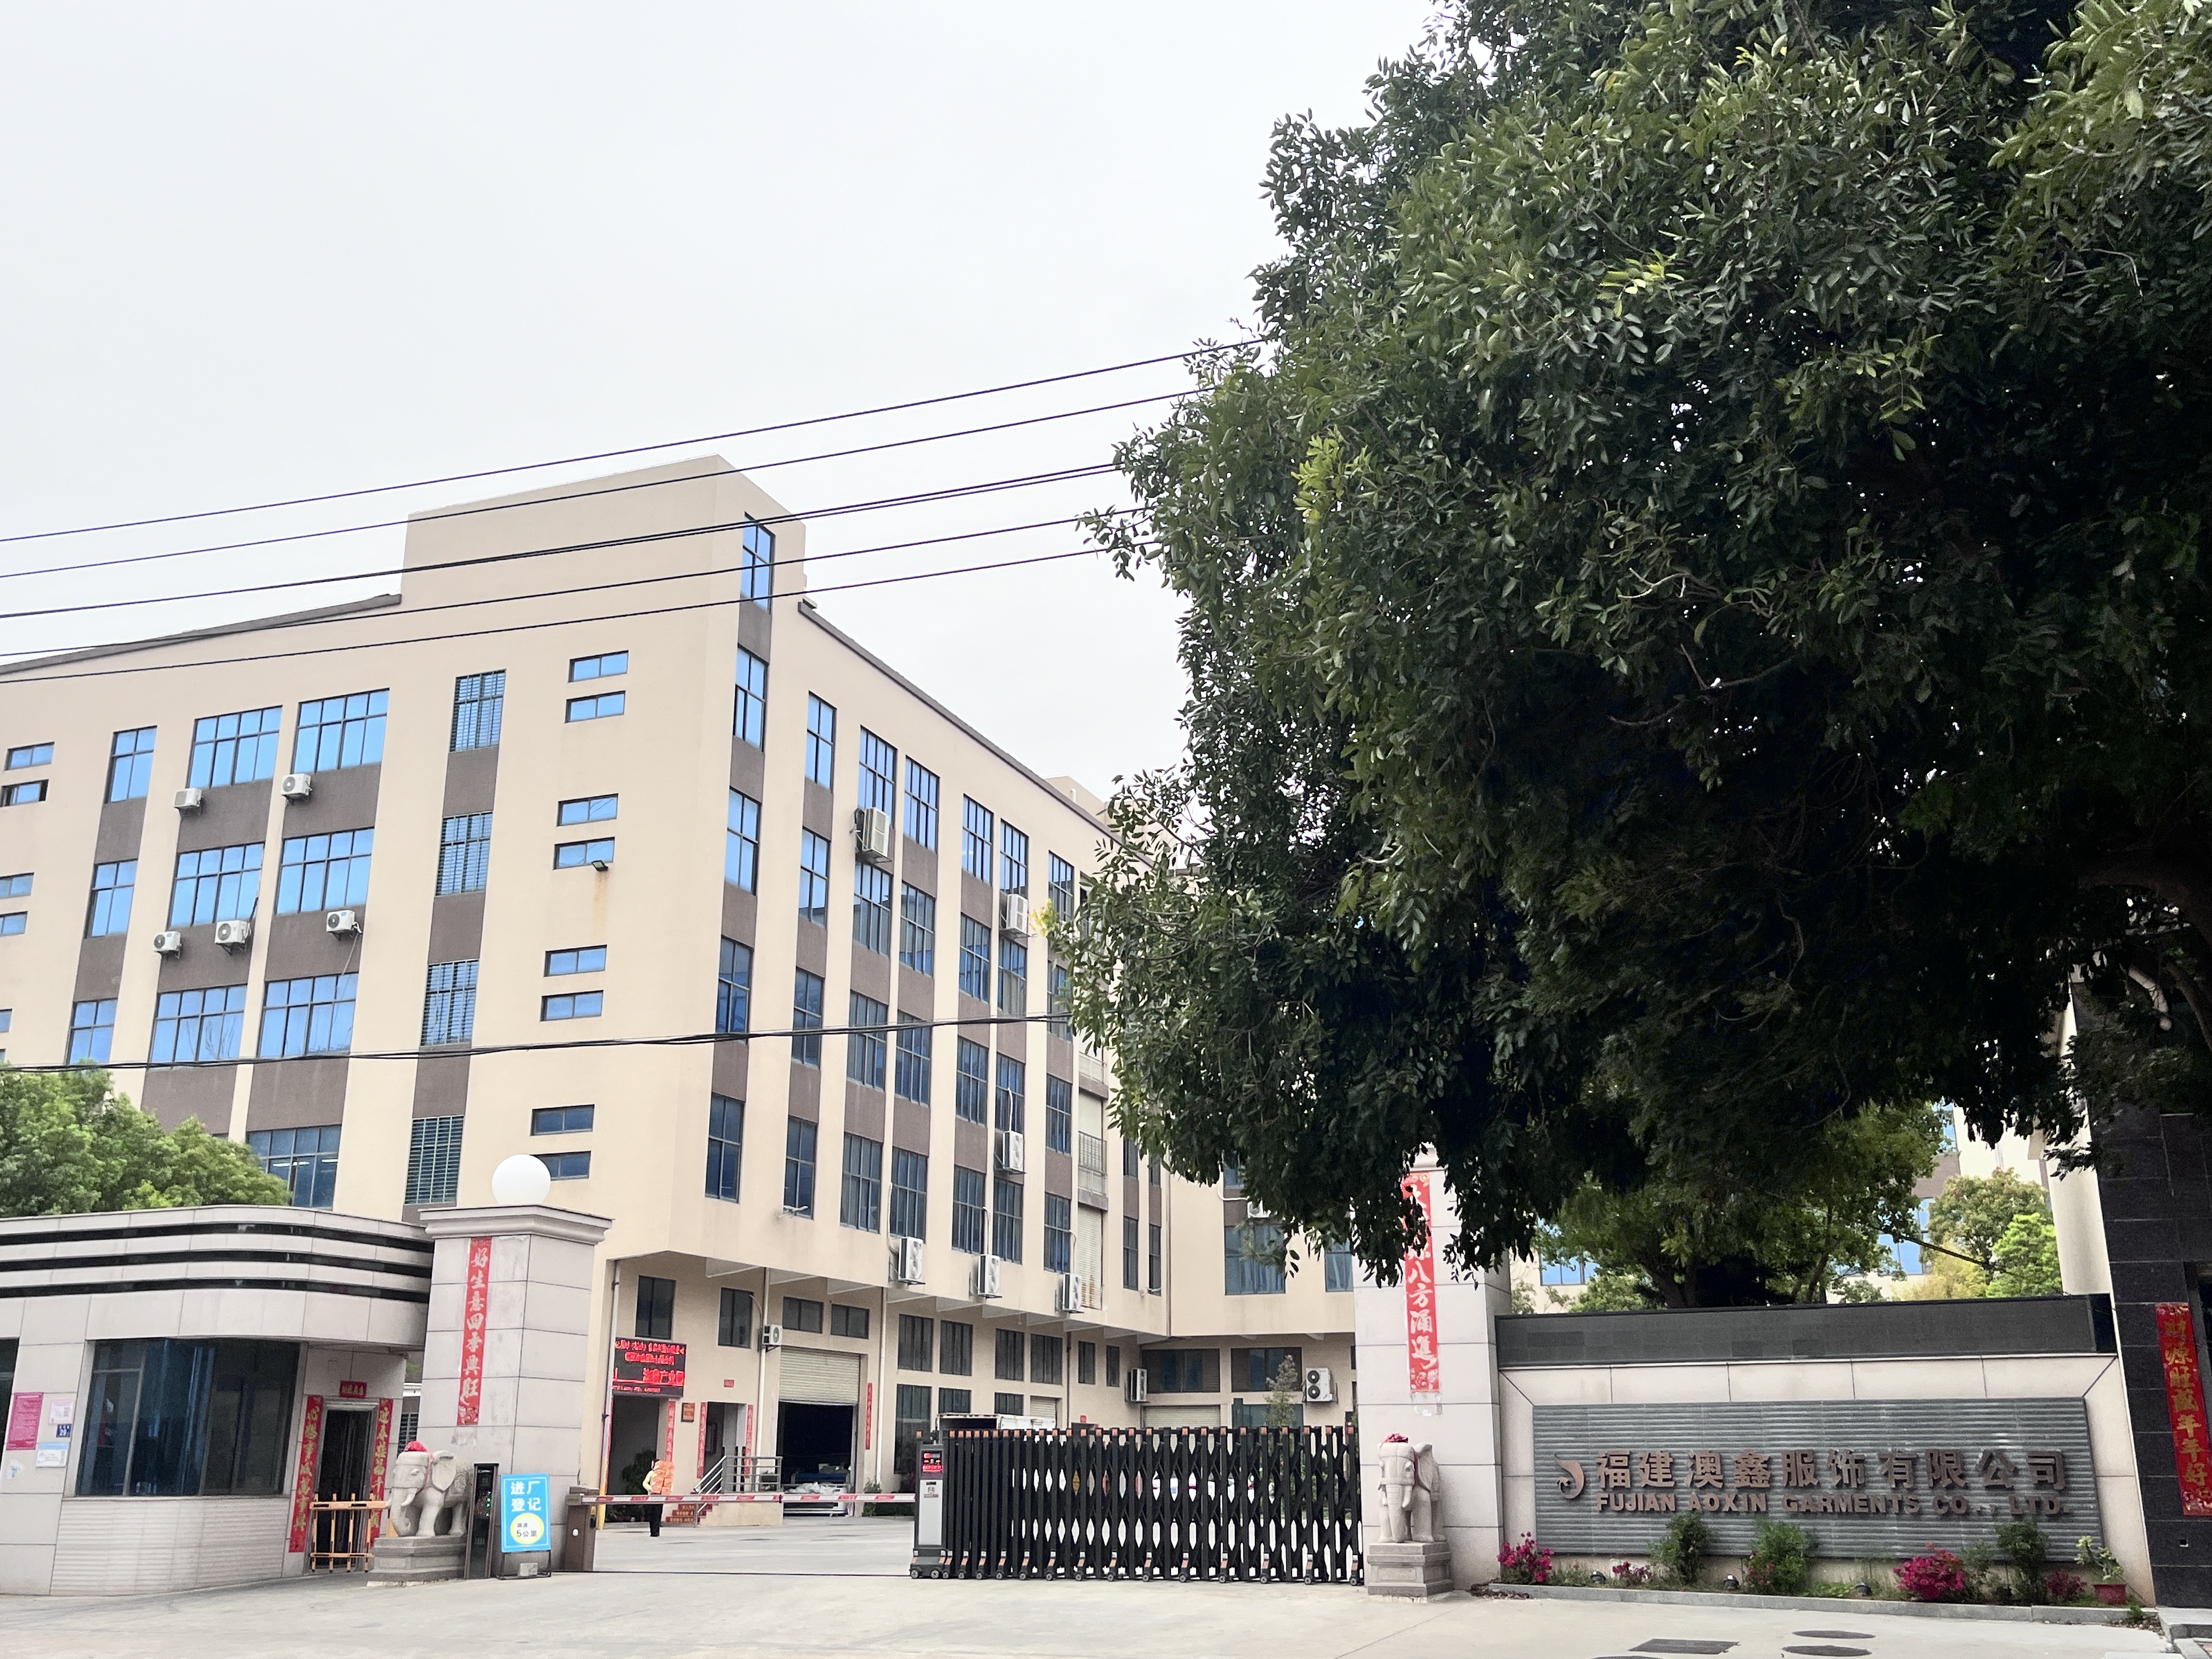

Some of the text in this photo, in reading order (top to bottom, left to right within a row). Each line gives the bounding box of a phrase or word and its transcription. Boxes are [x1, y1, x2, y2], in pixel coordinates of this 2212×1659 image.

[1595, 1449, 2066, 1491] 福建澳鑫服饰有限公司
[510, 1480, 541, 1495] 进厂
[511, 1497, 542, 1512] 登记
[1596, 1493, 1677, 1512] FUJIAN
[1688, 1492, 1768, 1513] AOXIN
[1781, 1493, 1920, 1514] GARMENTS
[2008, 1495, 2070, 1515] LTD.
